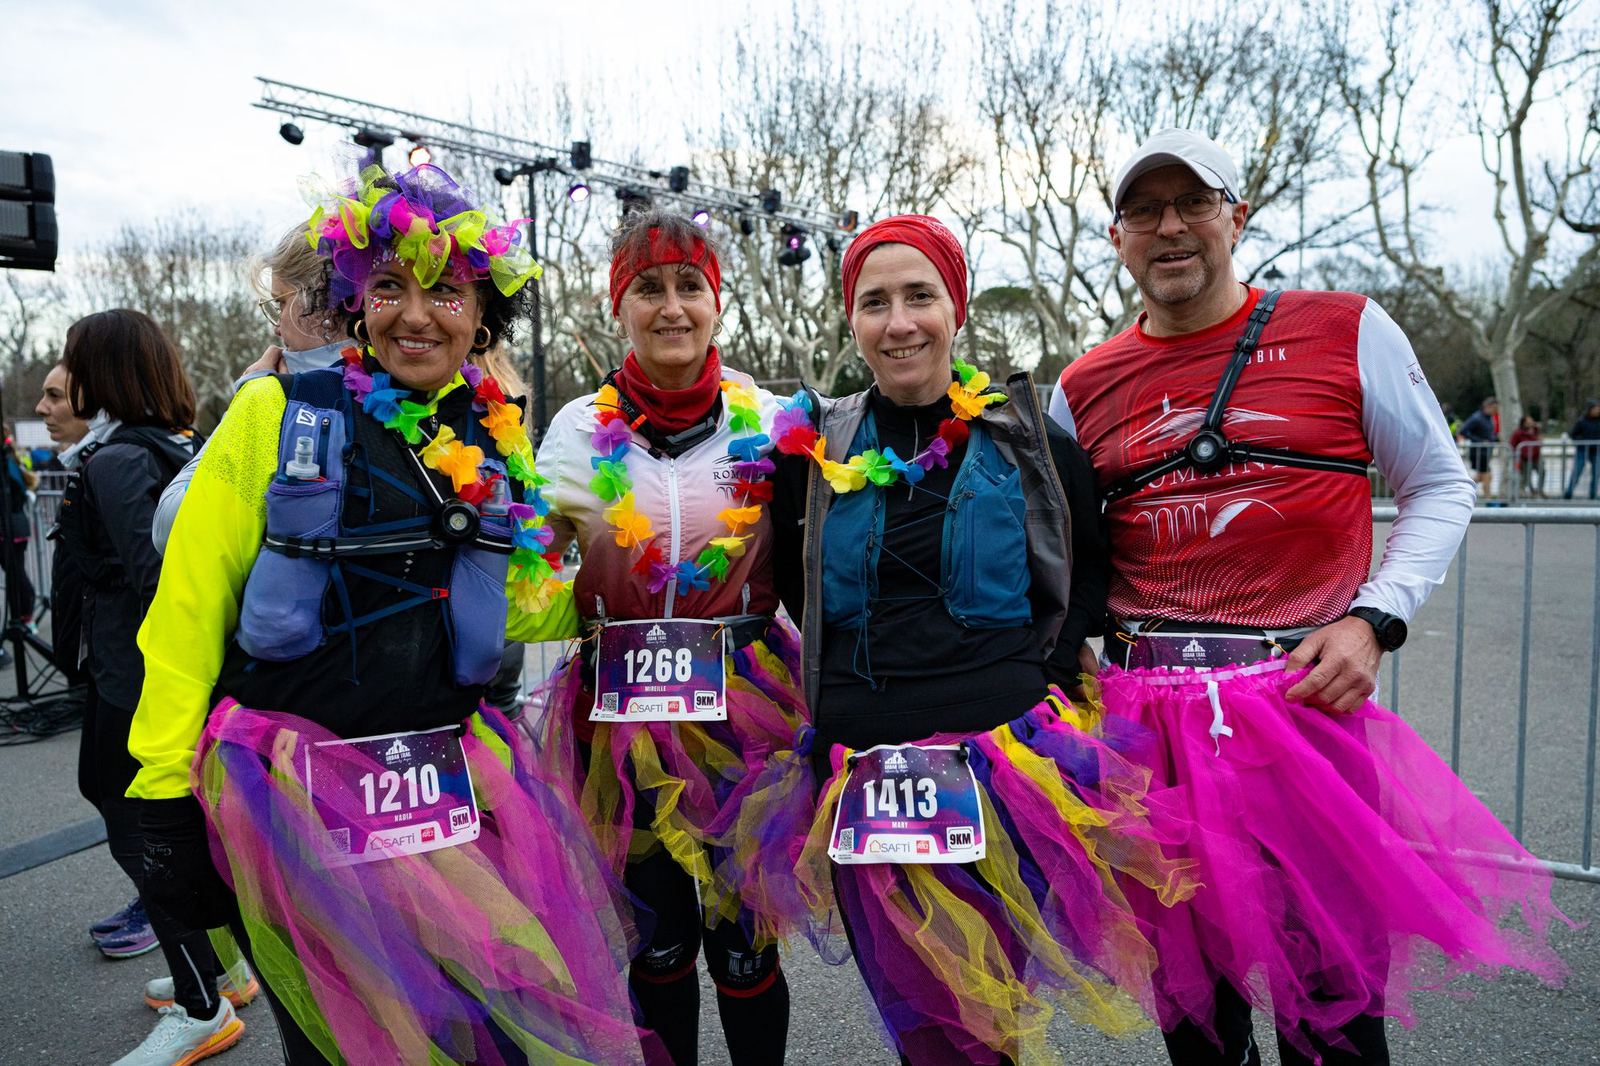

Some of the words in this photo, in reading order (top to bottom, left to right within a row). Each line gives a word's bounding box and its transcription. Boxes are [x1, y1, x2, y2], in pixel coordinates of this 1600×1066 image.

[624, 647, 692, 684] 1268
[696, 698, 714, 707] 9KM
[359, 763, 441, 815] 1210
[862, 777, 938, 819] 1413
[452, 812, 469, 827] 9KM
[950, 833, 971, 845] 9KM
